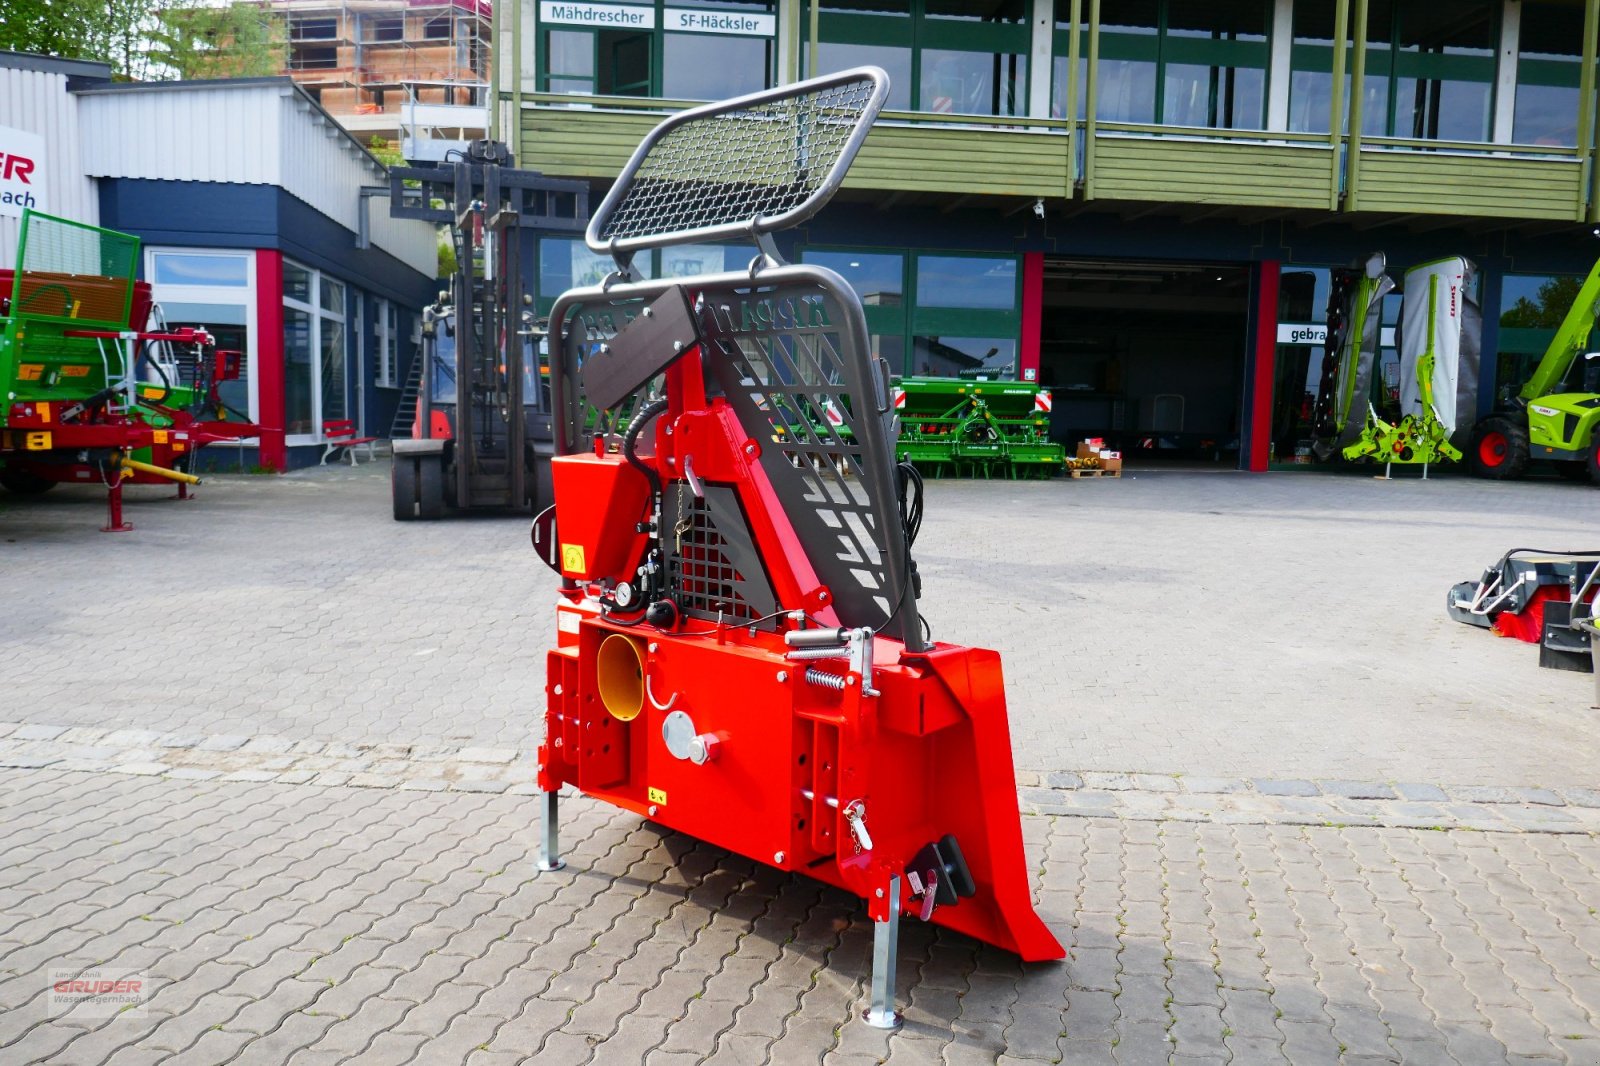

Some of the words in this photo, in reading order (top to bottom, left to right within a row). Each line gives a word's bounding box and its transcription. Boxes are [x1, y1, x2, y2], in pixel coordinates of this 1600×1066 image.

[551, 6, 645, 25] Mähdrescher
[679, 13, 760, 31] SF-Häcksler
[0, 151, 35, 185] R
[0, 191, 36, 208] ach
